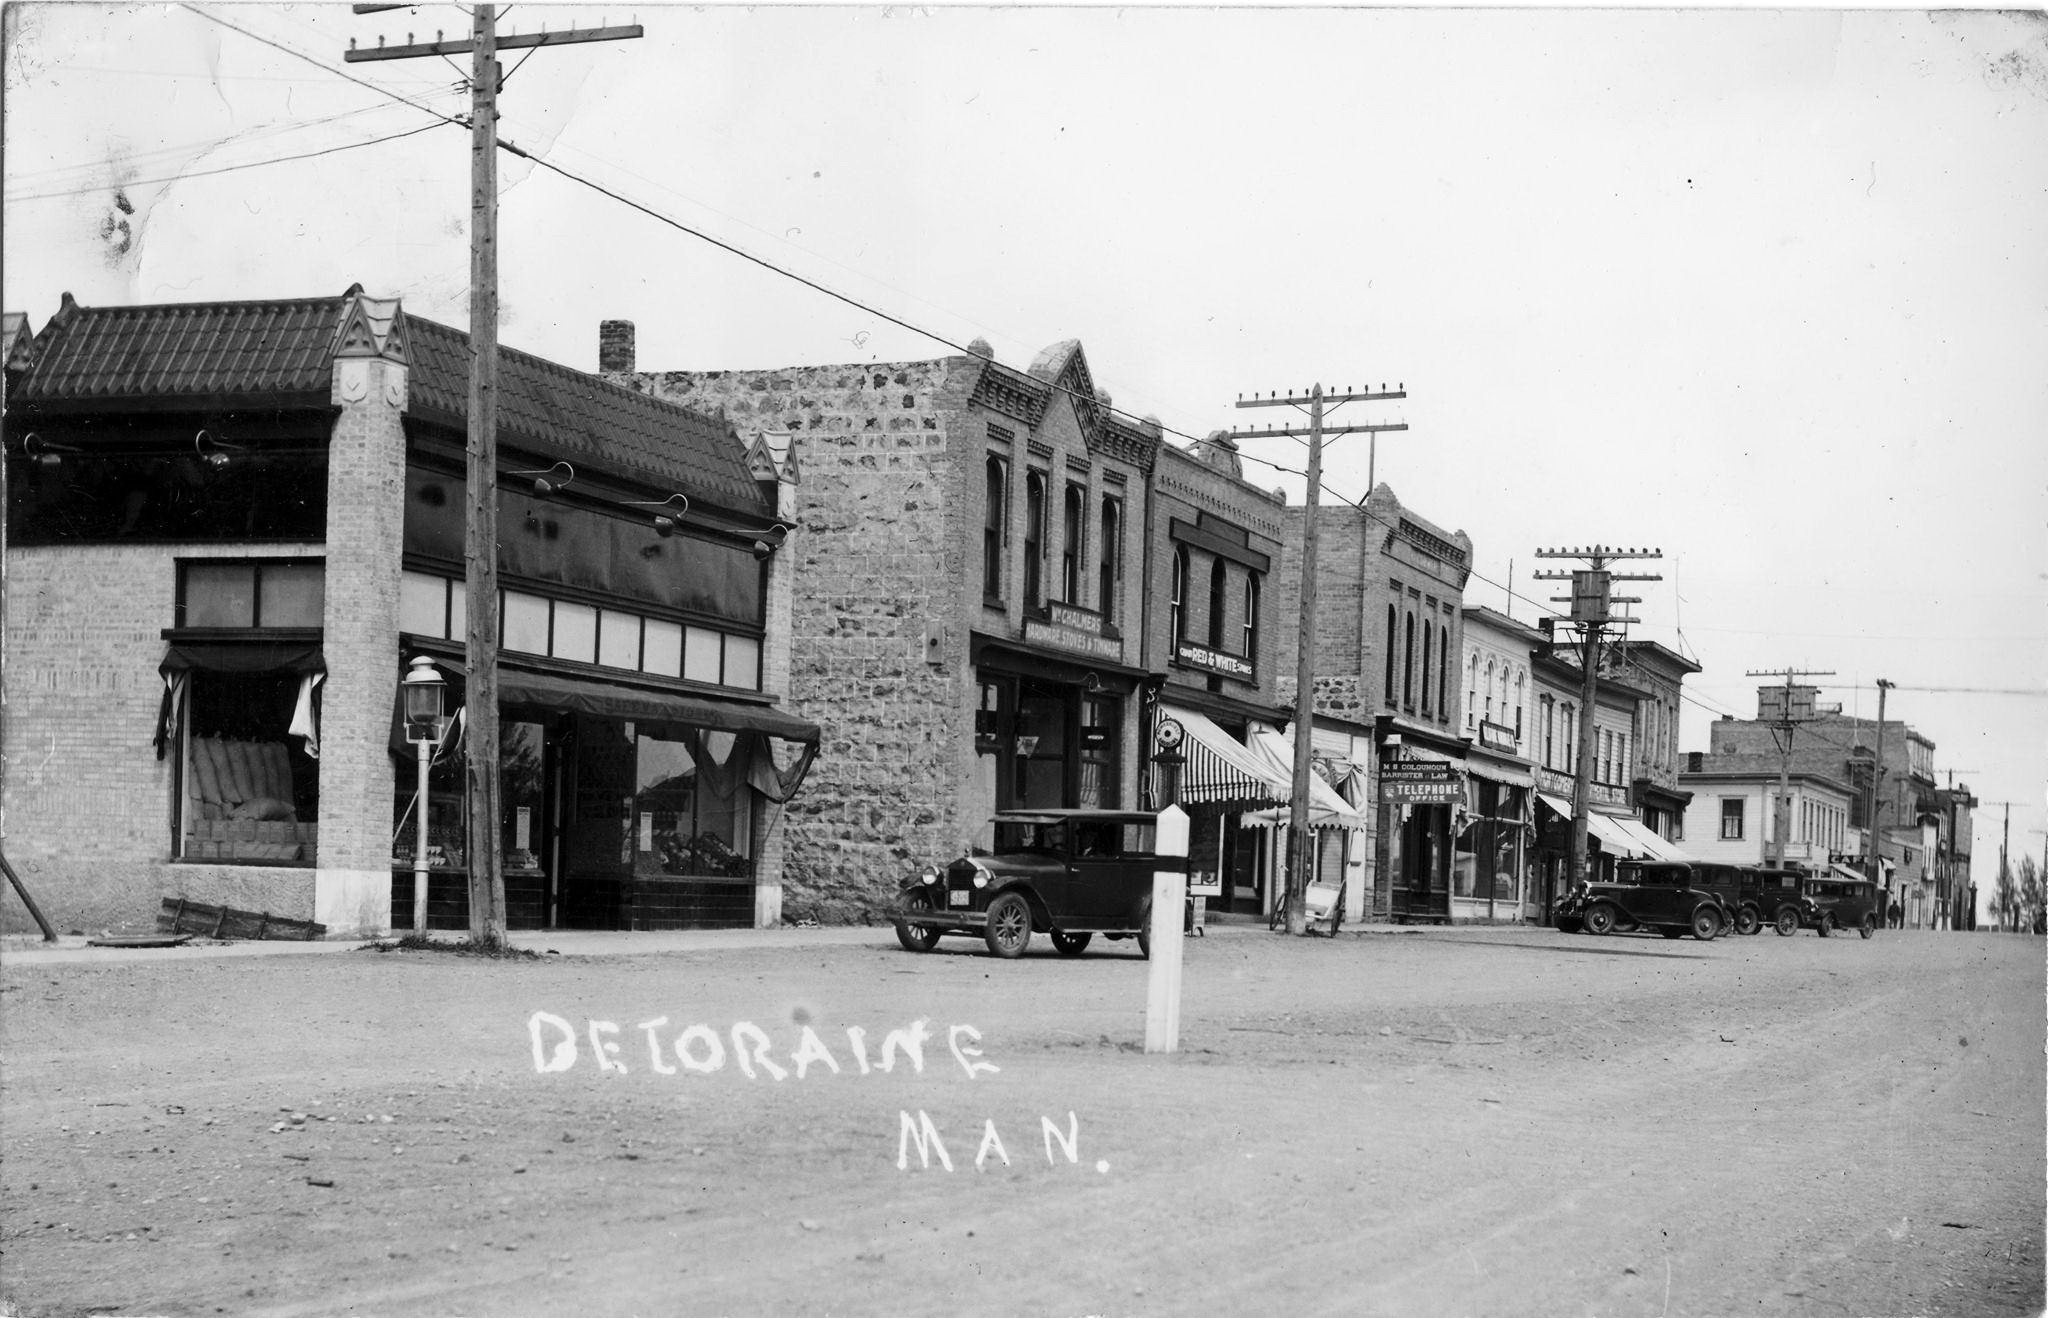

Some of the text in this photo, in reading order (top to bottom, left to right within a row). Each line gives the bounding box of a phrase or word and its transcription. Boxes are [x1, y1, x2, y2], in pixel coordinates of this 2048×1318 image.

[1062, 609, 1101, 633] CHALMERS
[1062, 630, 1086, 651] STOVES
[1192, 647, 1208, 664] RED
[1208, 652, 1215, 667] &
[1215, 654, 1238, 673] WHITE
[1396, 784, 1459, 795] TELEPHONE
